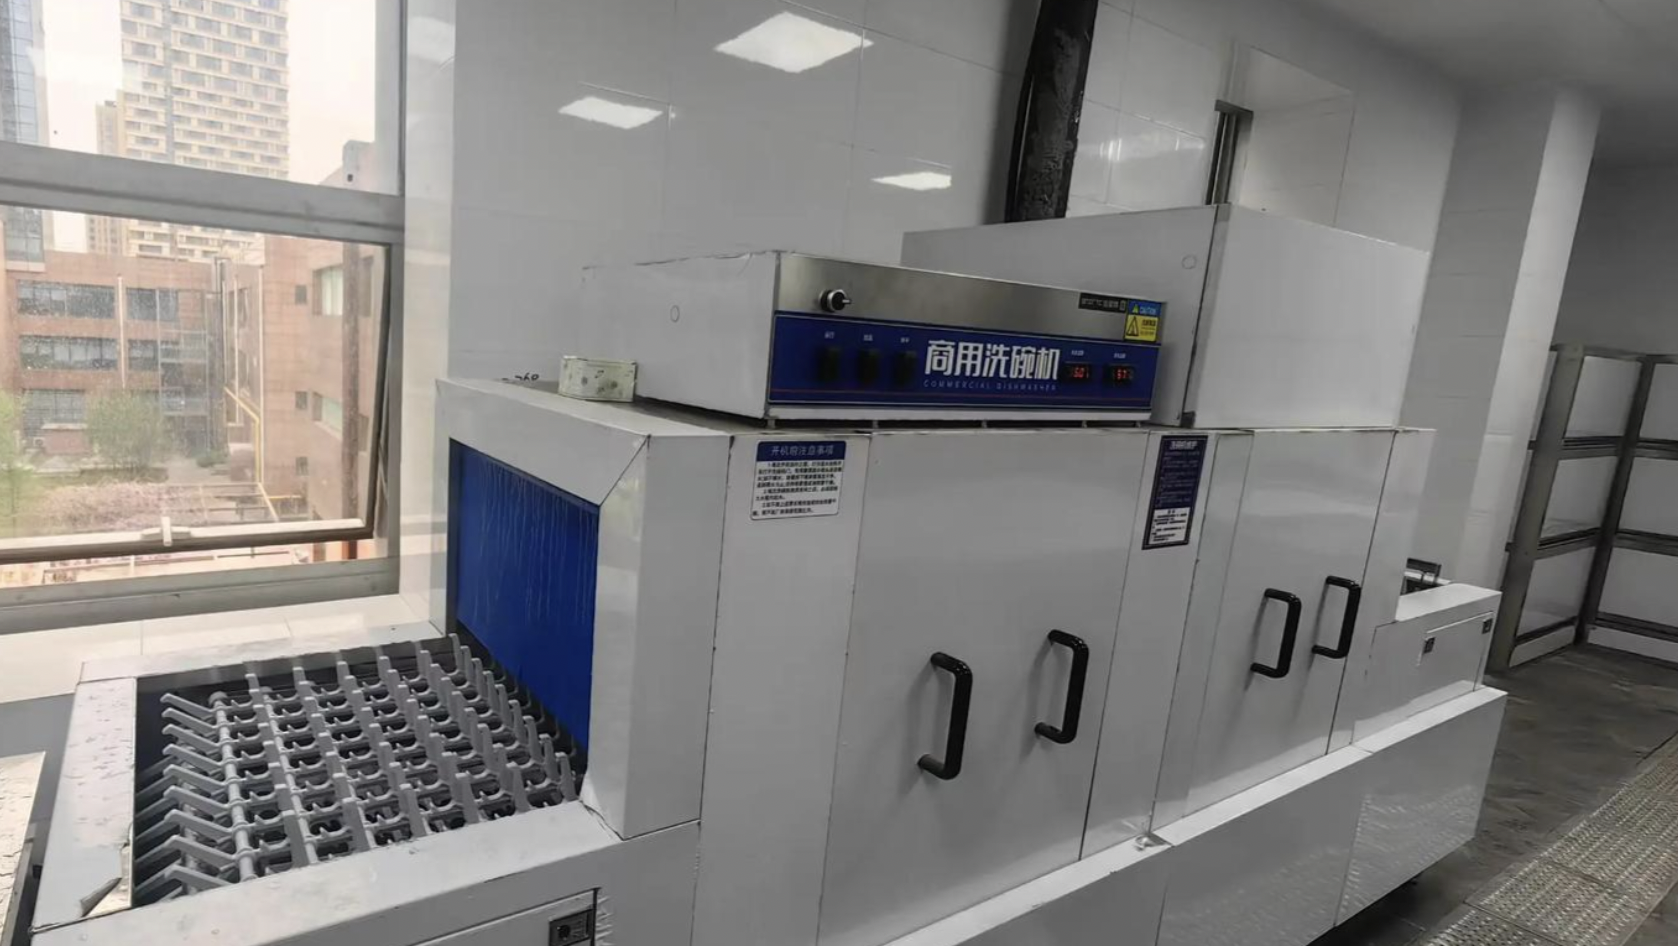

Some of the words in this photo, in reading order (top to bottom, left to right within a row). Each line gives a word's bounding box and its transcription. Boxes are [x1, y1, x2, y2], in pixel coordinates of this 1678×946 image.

[924, 340, 1060, 380] 商用洗碗机
